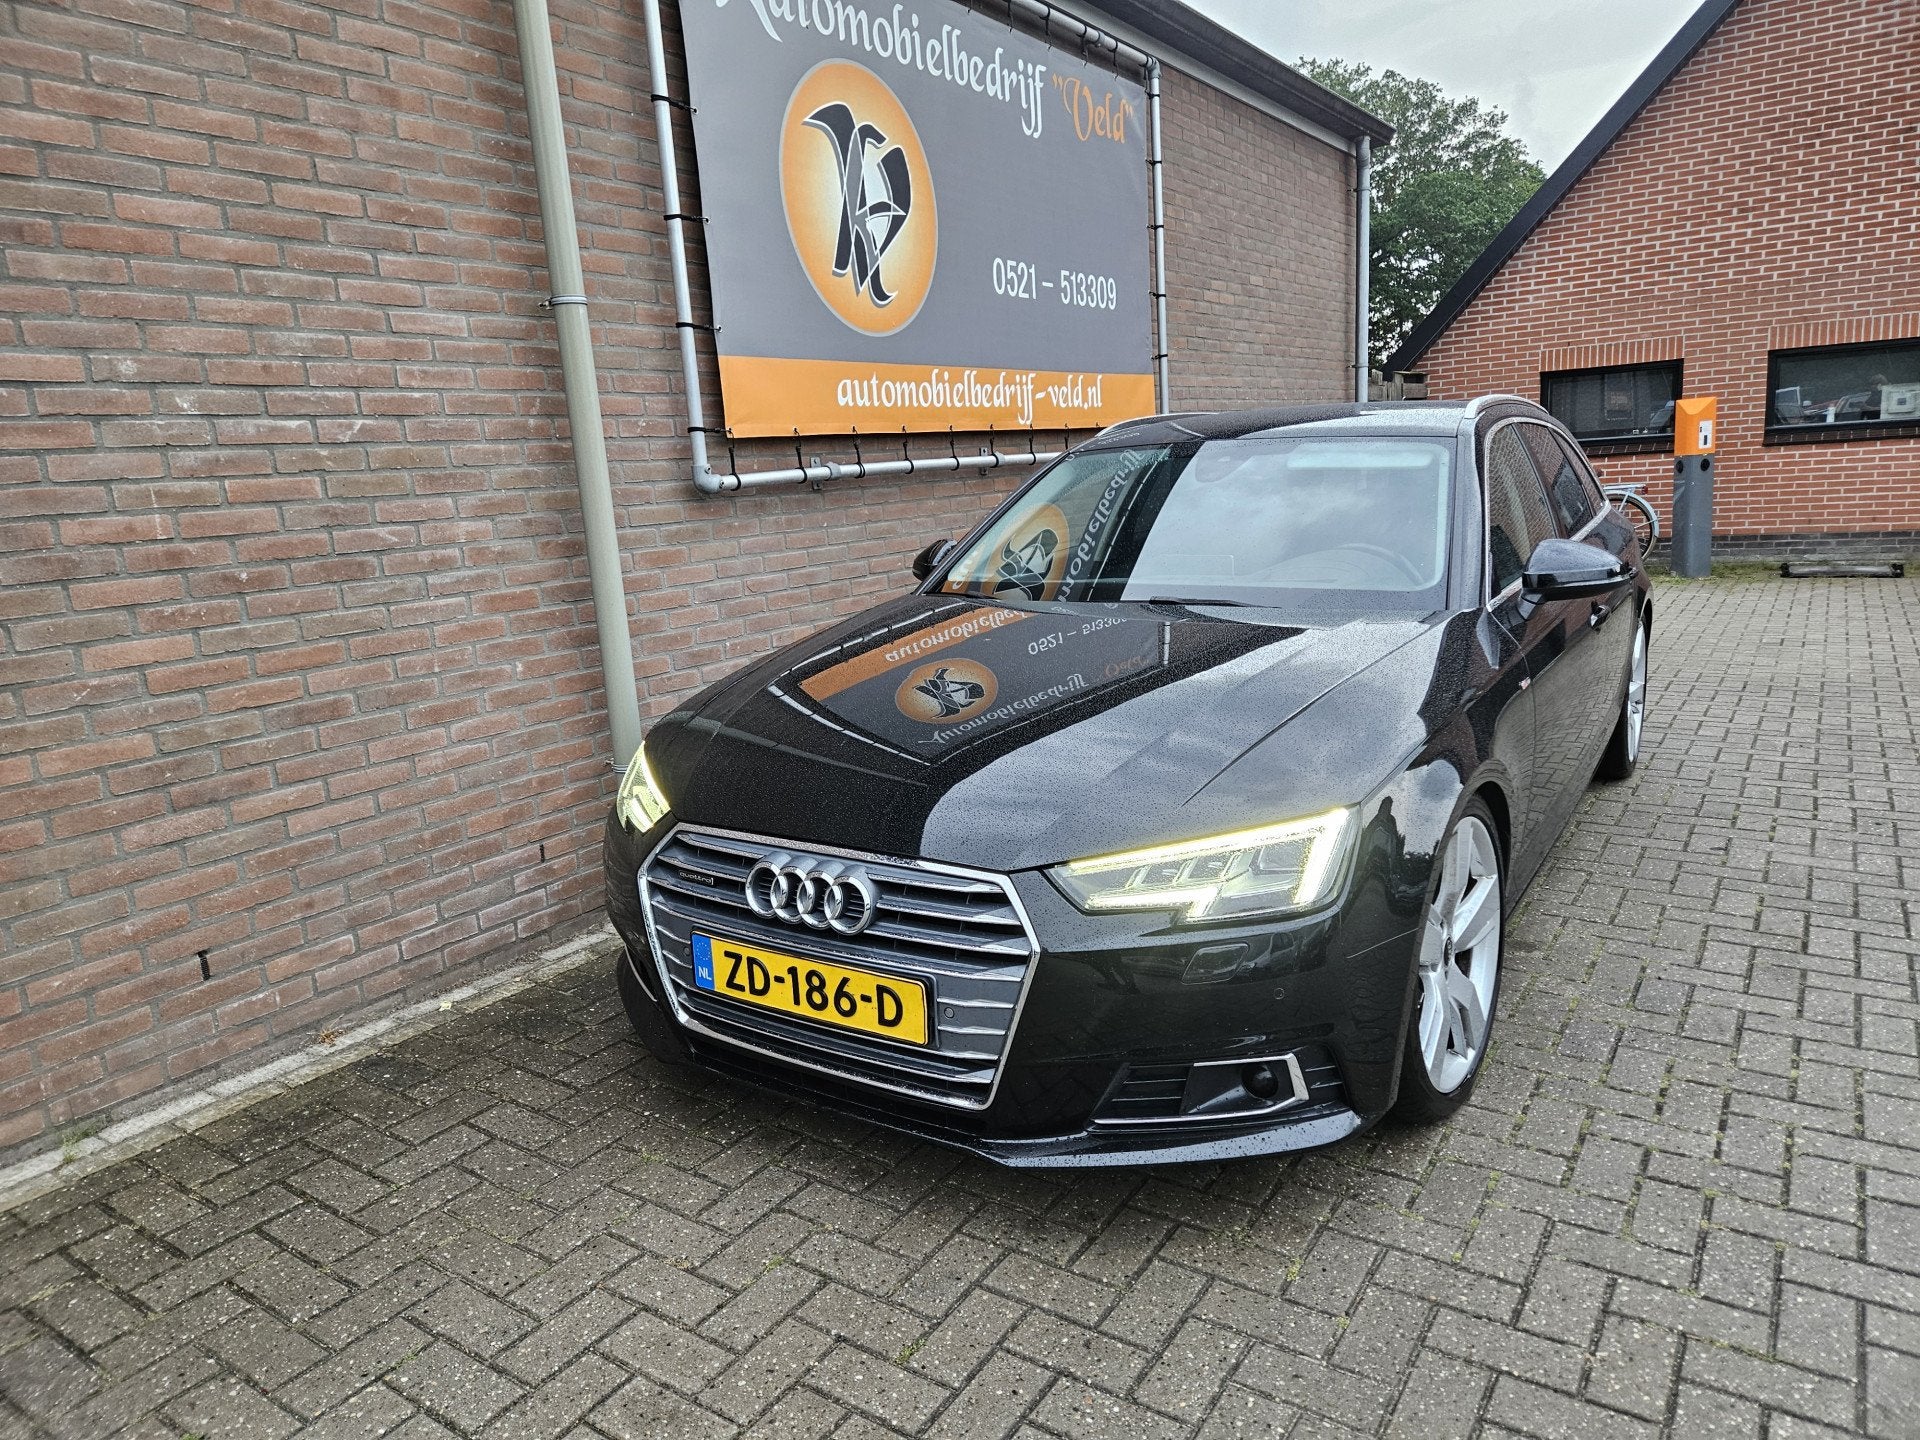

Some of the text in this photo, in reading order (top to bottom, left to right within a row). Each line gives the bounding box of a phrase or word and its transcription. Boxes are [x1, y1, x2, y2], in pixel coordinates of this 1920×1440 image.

[992, 257, 1036, 300] 0521
[1061, 269, 1117, 310] 513309
[837, 368, 1102, 425] automobielbedrijf-veld.nl
[679, 871, 712, 884] quattro
[698, 950, 903, 1027] NL ZD-186-D
